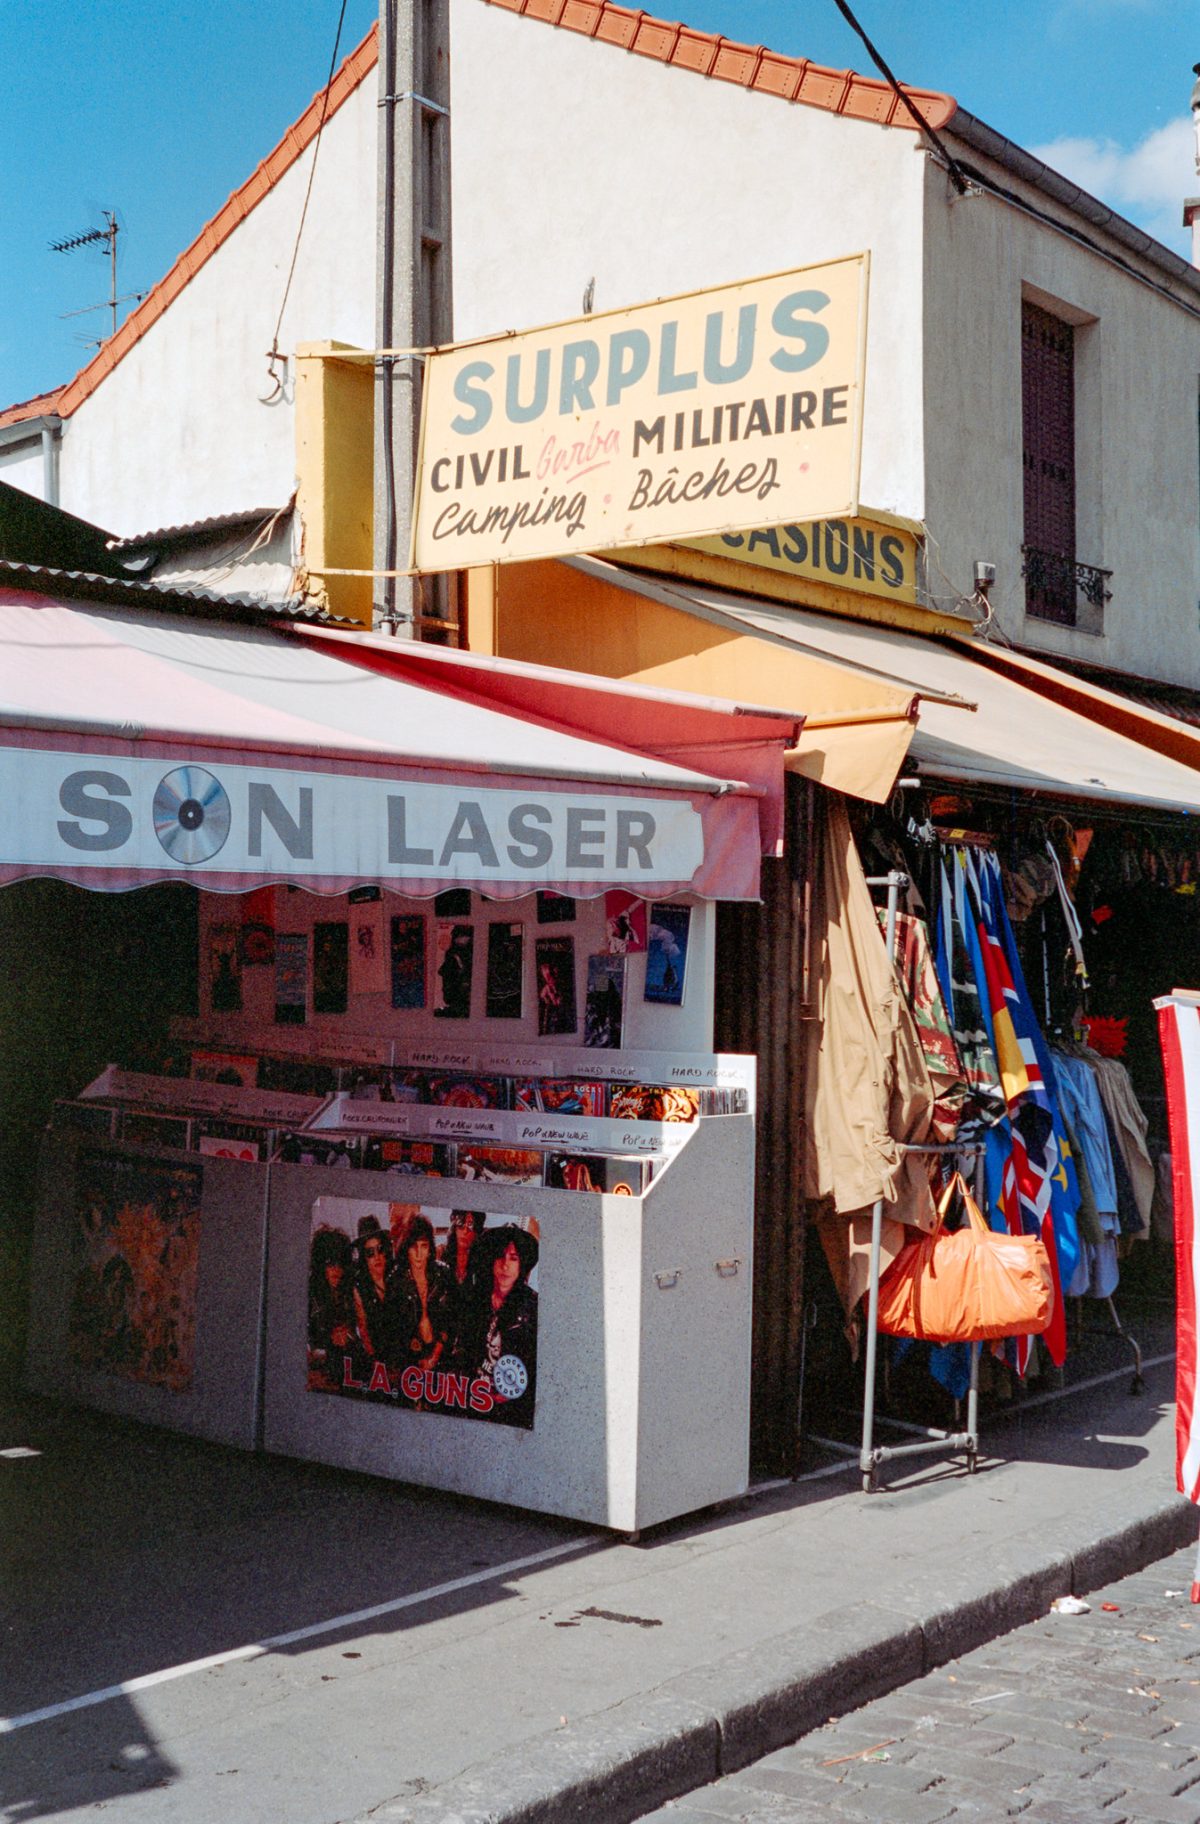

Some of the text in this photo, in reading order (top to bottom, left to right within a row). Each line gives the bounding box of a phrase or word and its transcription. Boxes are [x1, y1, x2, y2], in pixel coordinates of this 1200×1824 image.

[450, 289, 832, 436] SURPLUS
[430, 444, 531, 494] CIVIL
[632, 384, 849, 459] MILITAIRE
[432, 457, 781, 543] Camping Bâches
[387, 795, 656, 870] LASER
[672, 1067, 702, 1077] HARD
[401, 1366, 494, 1413] GUNS
